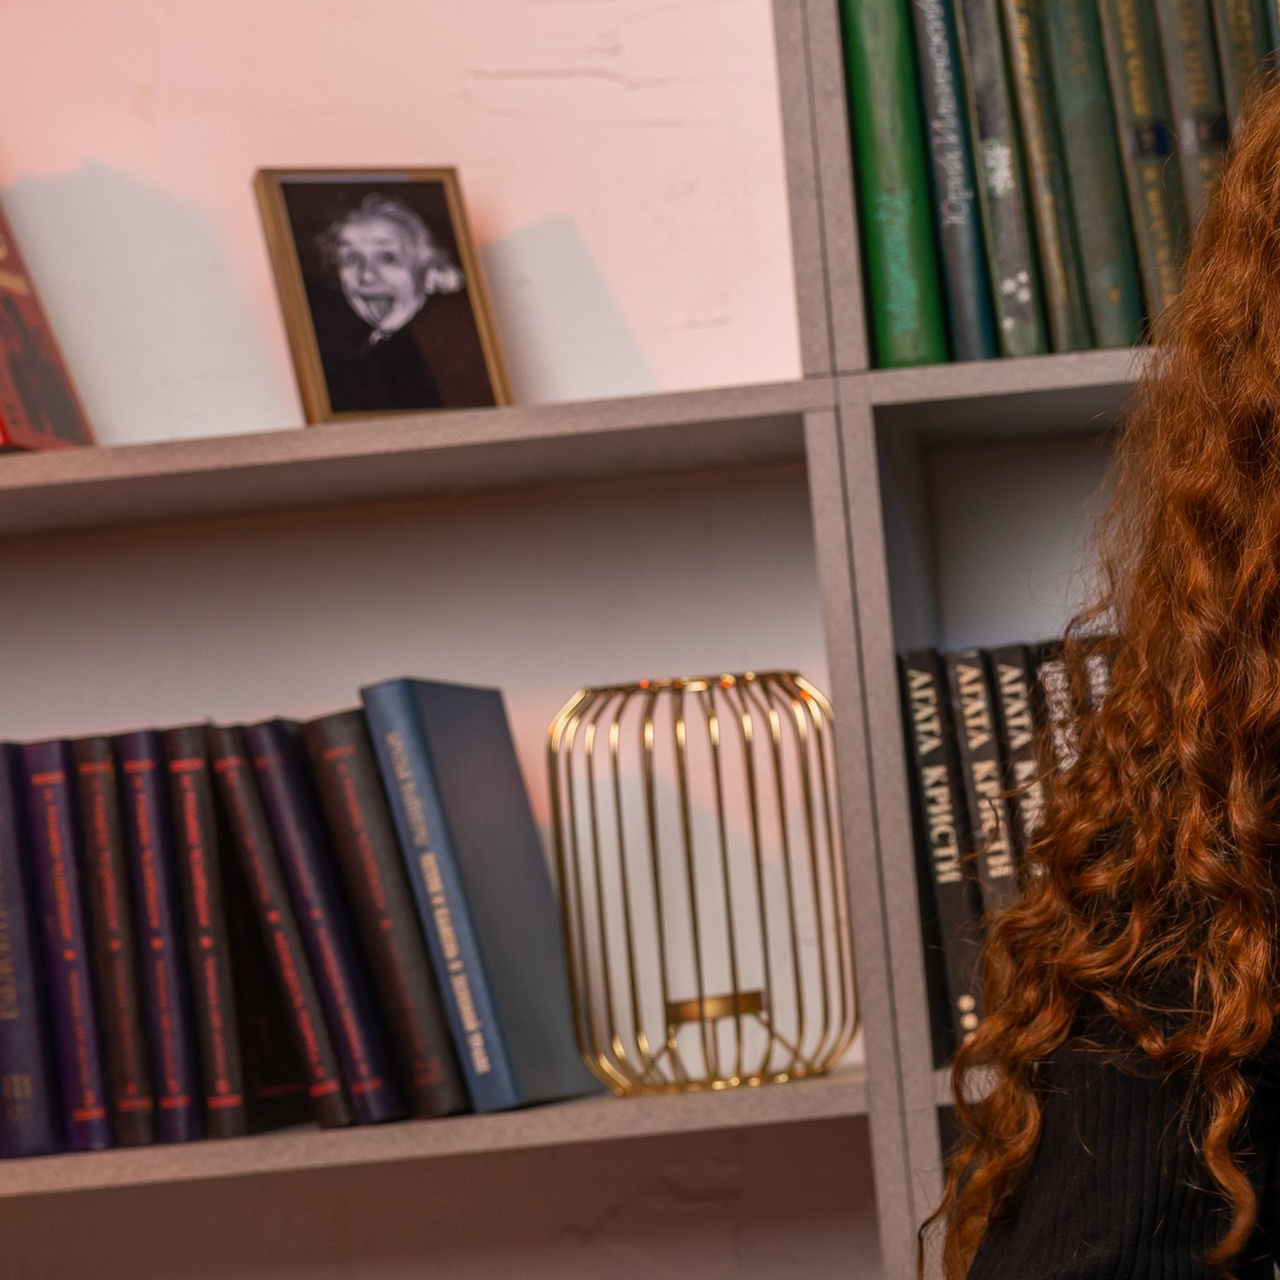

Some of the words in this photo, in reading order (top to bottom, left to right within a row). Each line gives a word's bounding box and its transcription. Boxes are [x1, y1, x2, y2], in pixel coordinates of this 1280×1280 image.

[909, 669, 943, 756] АГАТА
[956, 664, 991, 750] АГАТА
[998, 664, 1033, 750] АГАТА
[922, 764, 963, 884] КРИСТИ
[972, 760, 1014, 879] КРИСТИ
[1015, 760, 1045, 835] КРИ
